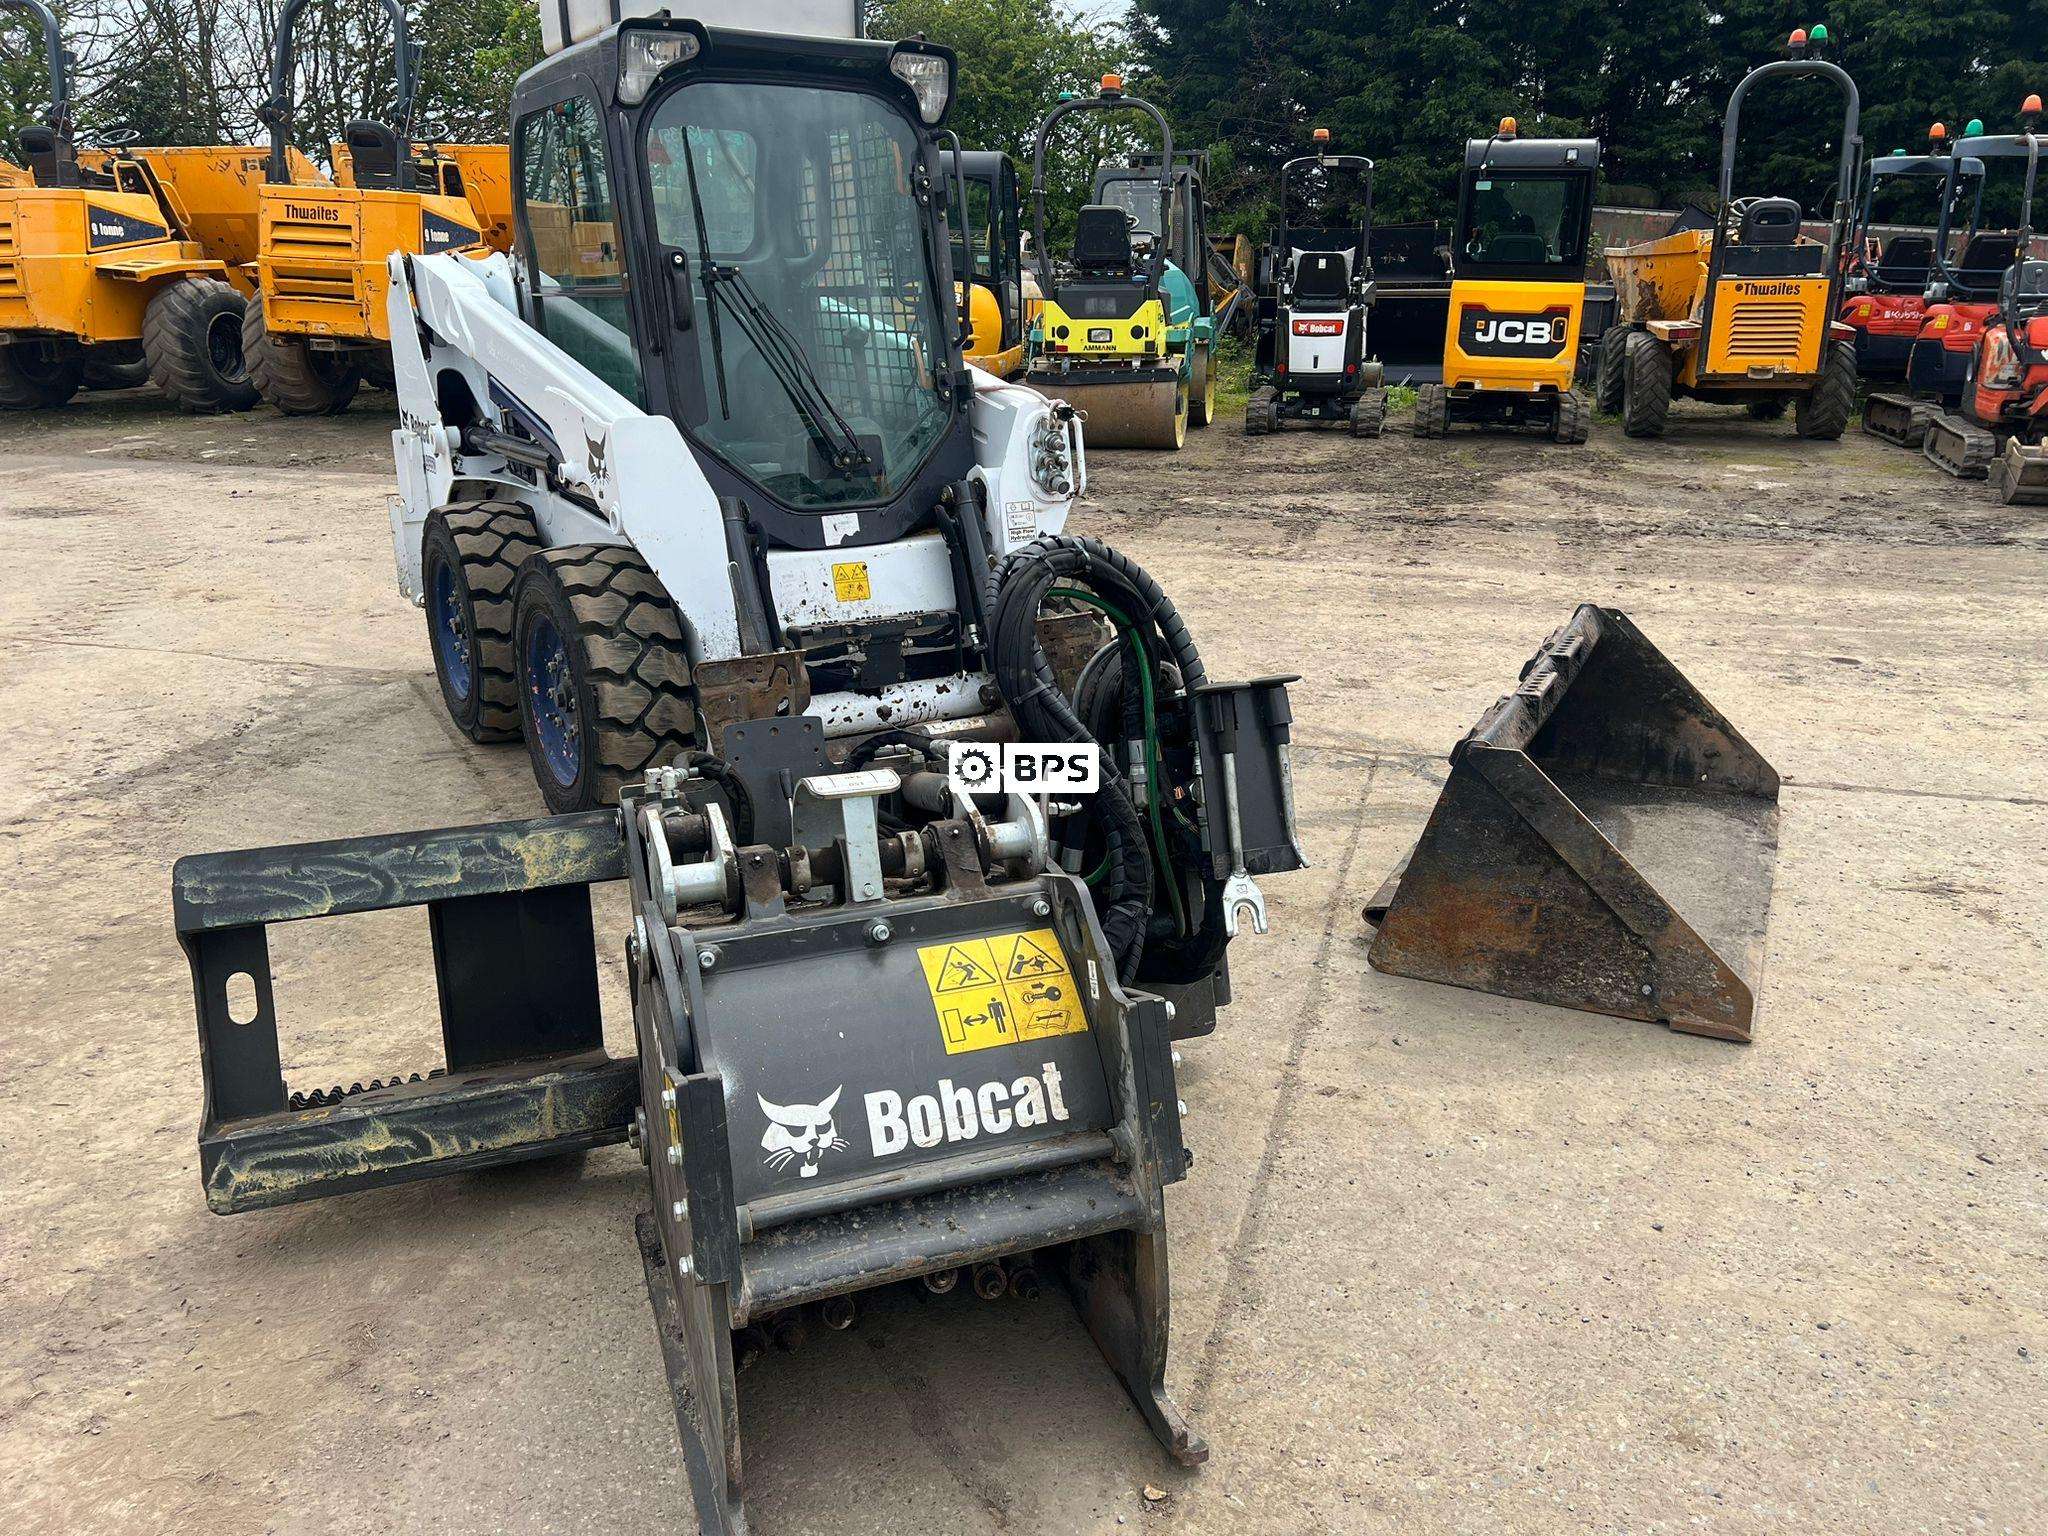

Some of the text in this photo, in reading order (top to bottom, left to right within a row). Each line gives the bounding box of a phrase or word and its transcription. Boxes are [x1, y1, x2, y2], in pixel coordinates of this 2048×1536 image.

[284, 204, 339, 221] Thwaites
[91, 222, 125, 237] 9 tonne
[424, 228, 430, 242] 9
[1744, 282, 1801, 296] Thwaites
[1310, 324, 1336, 333] Bobcat
[1475, 320, 1551, 344] JCB
[864, 1061, 1070, 1158] Bobcat
